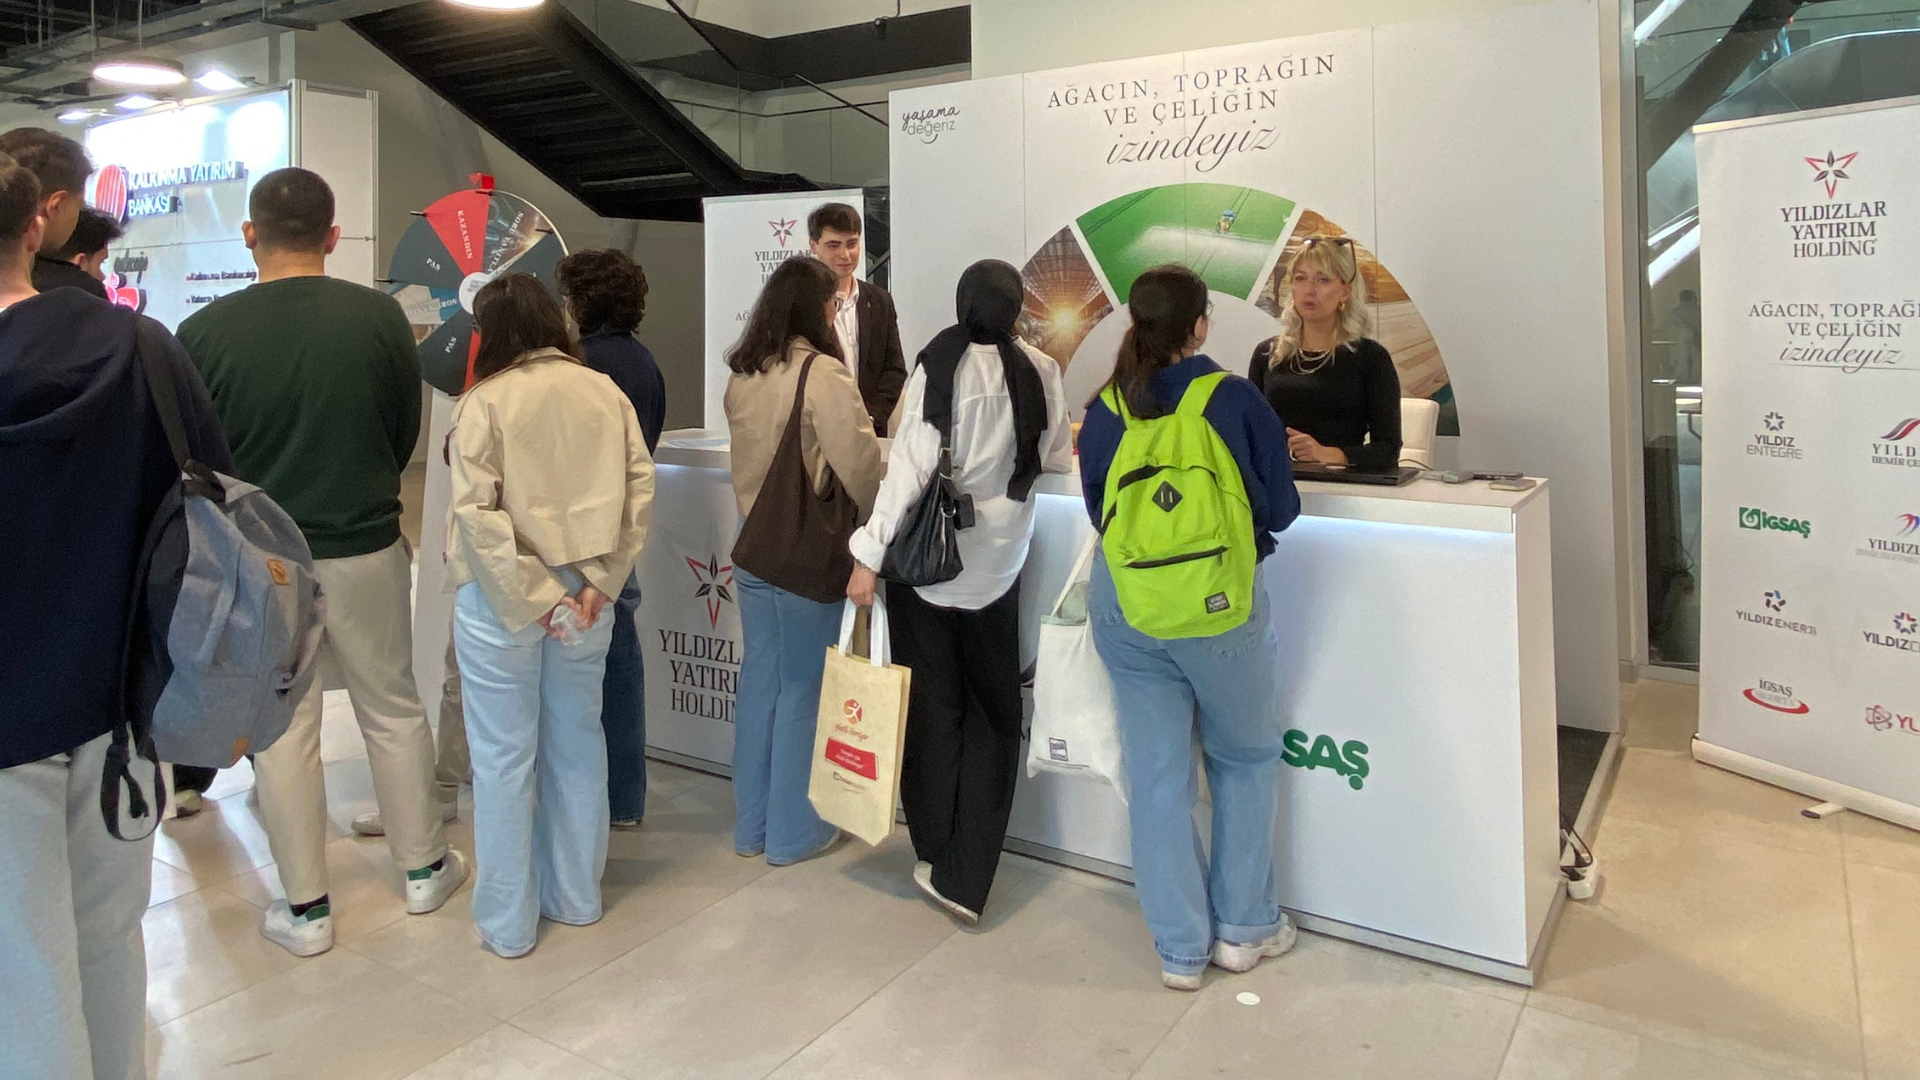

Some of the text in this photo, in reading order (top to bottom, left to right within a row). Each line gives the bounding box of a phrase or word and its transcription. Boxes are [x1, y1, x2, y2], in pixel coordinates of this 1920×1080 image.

[1047, 54, 1335, 108] AĞACIN, TOPRAĞIN
[1103, 86, 1278, 126] VE ÇELİĞİN
[901, 106, 961, 132] yaşama
[907, 119, 956, 137] değeriz
[1106, 115, 1281, 173] izindeyiz
[190, 160, 237, 182] YATIRIM
[1780, 200, 1887, 223] YILDIZLAR
[457, 209, 473, 260] KAZANDIN
[1791, 220, 1876, 240] YATIRIM
[426, 257, 441, 271] PAS
[1748, 300, 1825, 319] AĞACIN,
[1787, 319, 1902, 339] VE ÇELİĞİN
[444, 336, 458, 353] PAS
[1779, 335, 1903, 374] izindeyiz
[1746, 444, 1803, 460] ENTEGRE
[1754, 434, 1796, 448] YILDIZ
[1872, 443, 1920, 458] YILD
[1868, 538, 1920, 556] YILDIZL
[658, 628, 741, 666] YILDIZL
[669, 659, 739, 695] YATIRI
[1280, 728, 1370, 791] SAŞ
